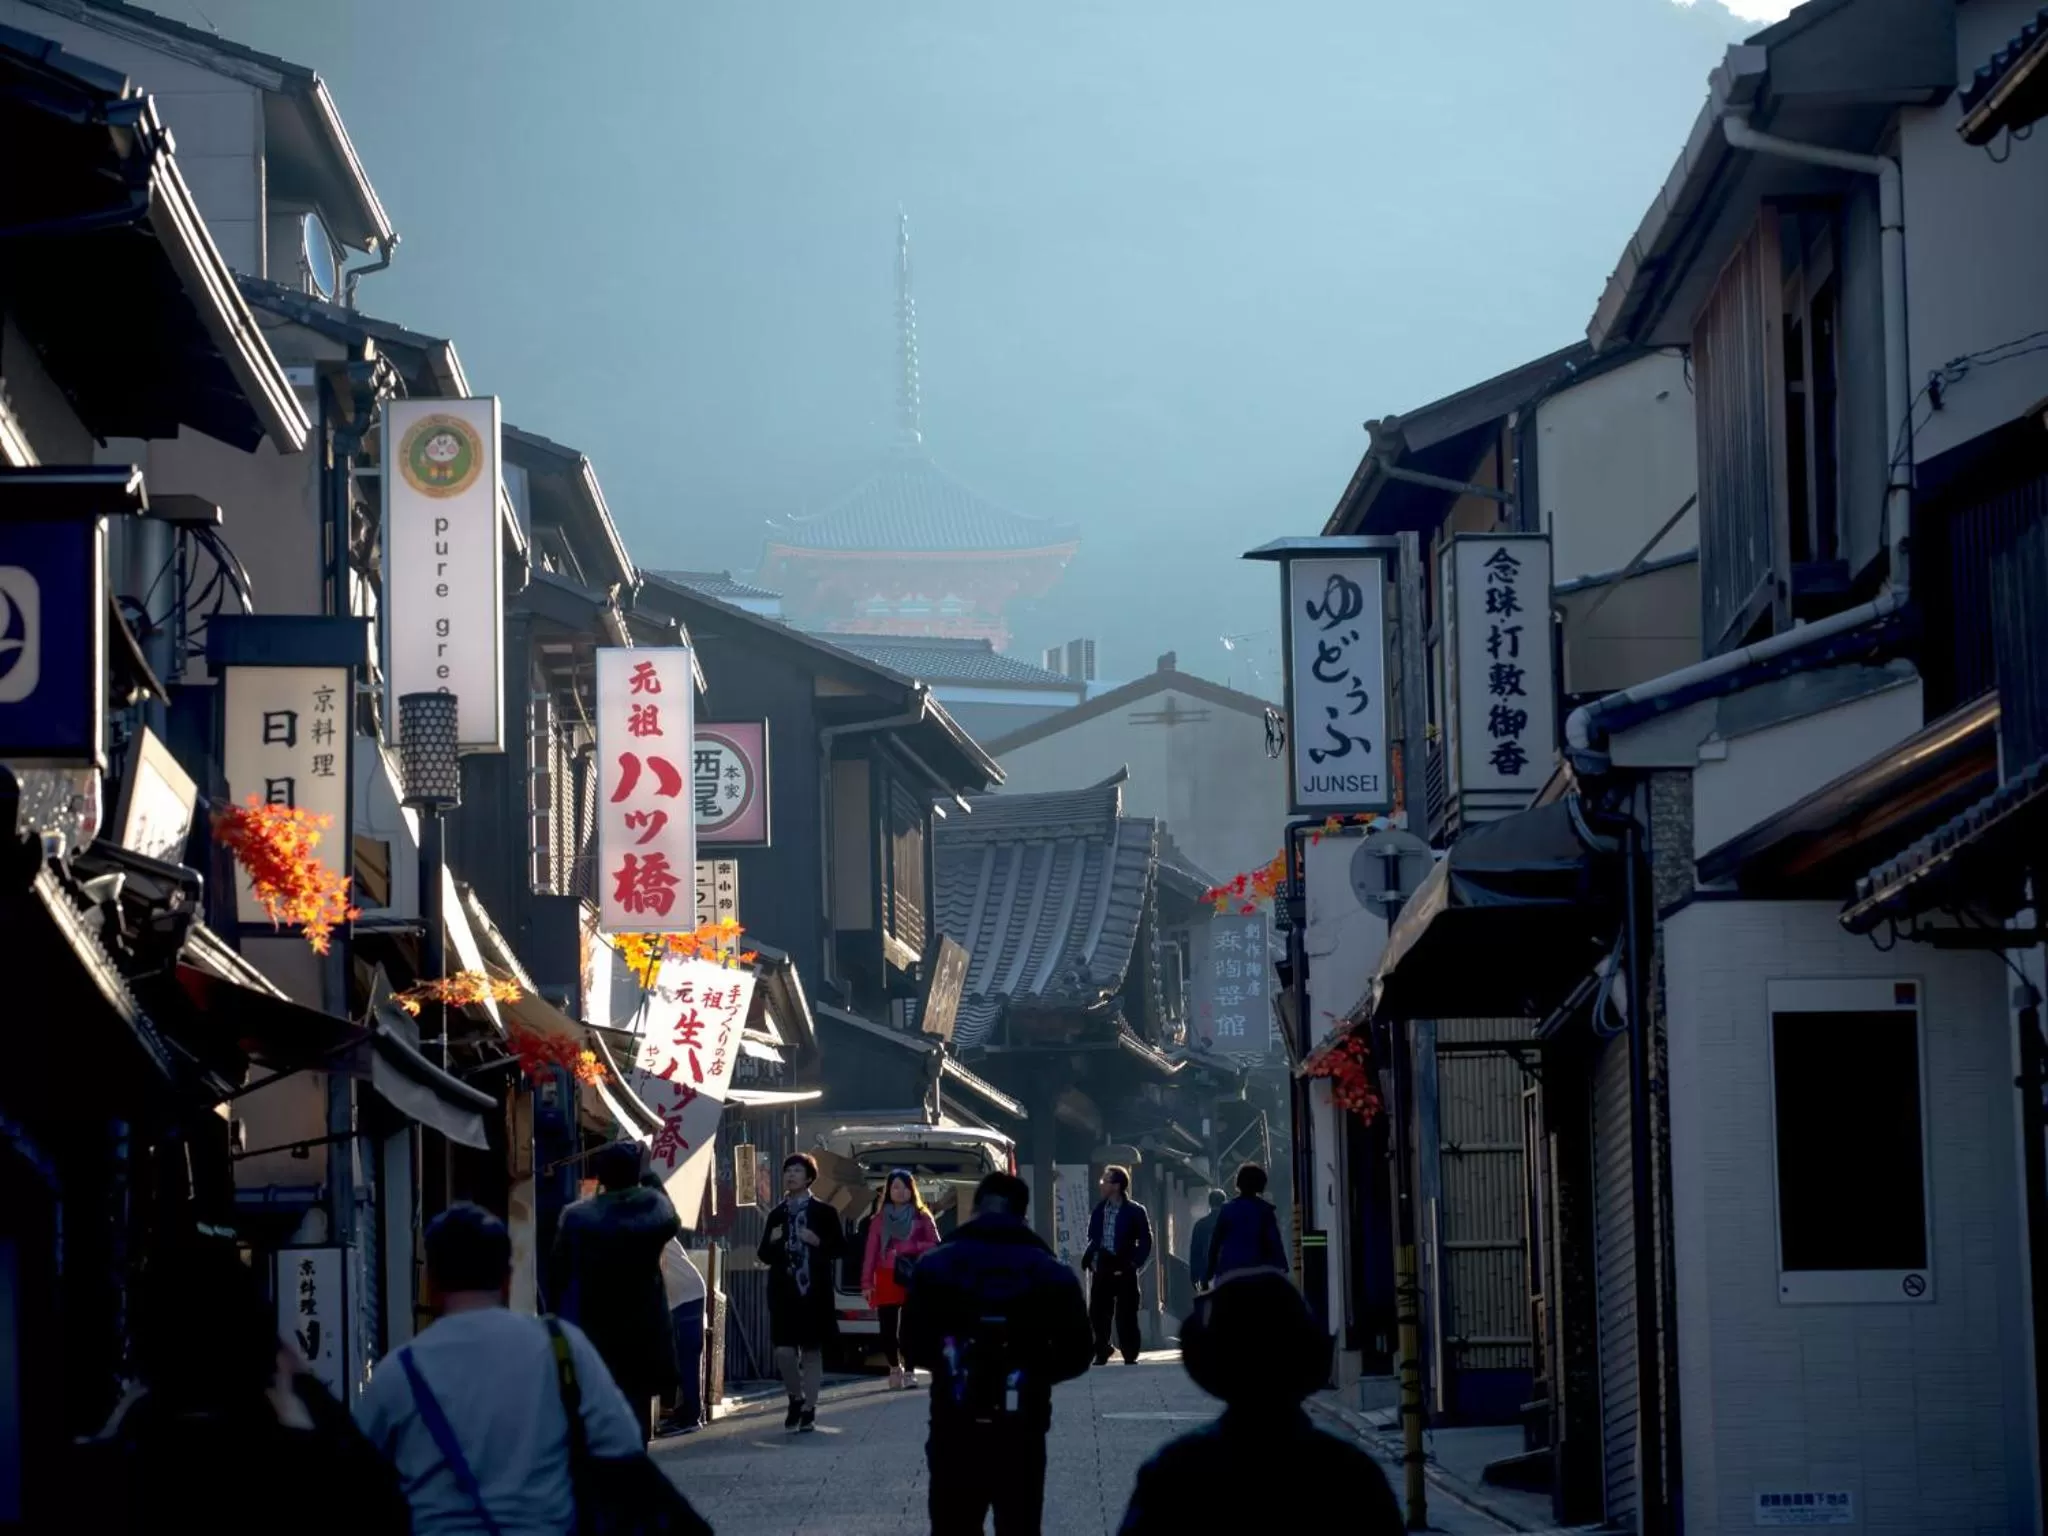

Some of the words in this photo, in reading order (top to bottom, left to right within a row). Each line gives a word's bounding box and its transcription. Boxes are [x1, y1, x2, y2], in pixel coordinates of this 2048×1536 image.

[435, 517, 450, 597] pure
[1306, 573, 1372, 764] ゆどうふ
[311, 685, 336, 777] 京料理
[724, 765, 741, 799] 本家
[1303, 774, 1379, 793] JUNSEI
[707, 984, 742, 1076] 手づくりの店
